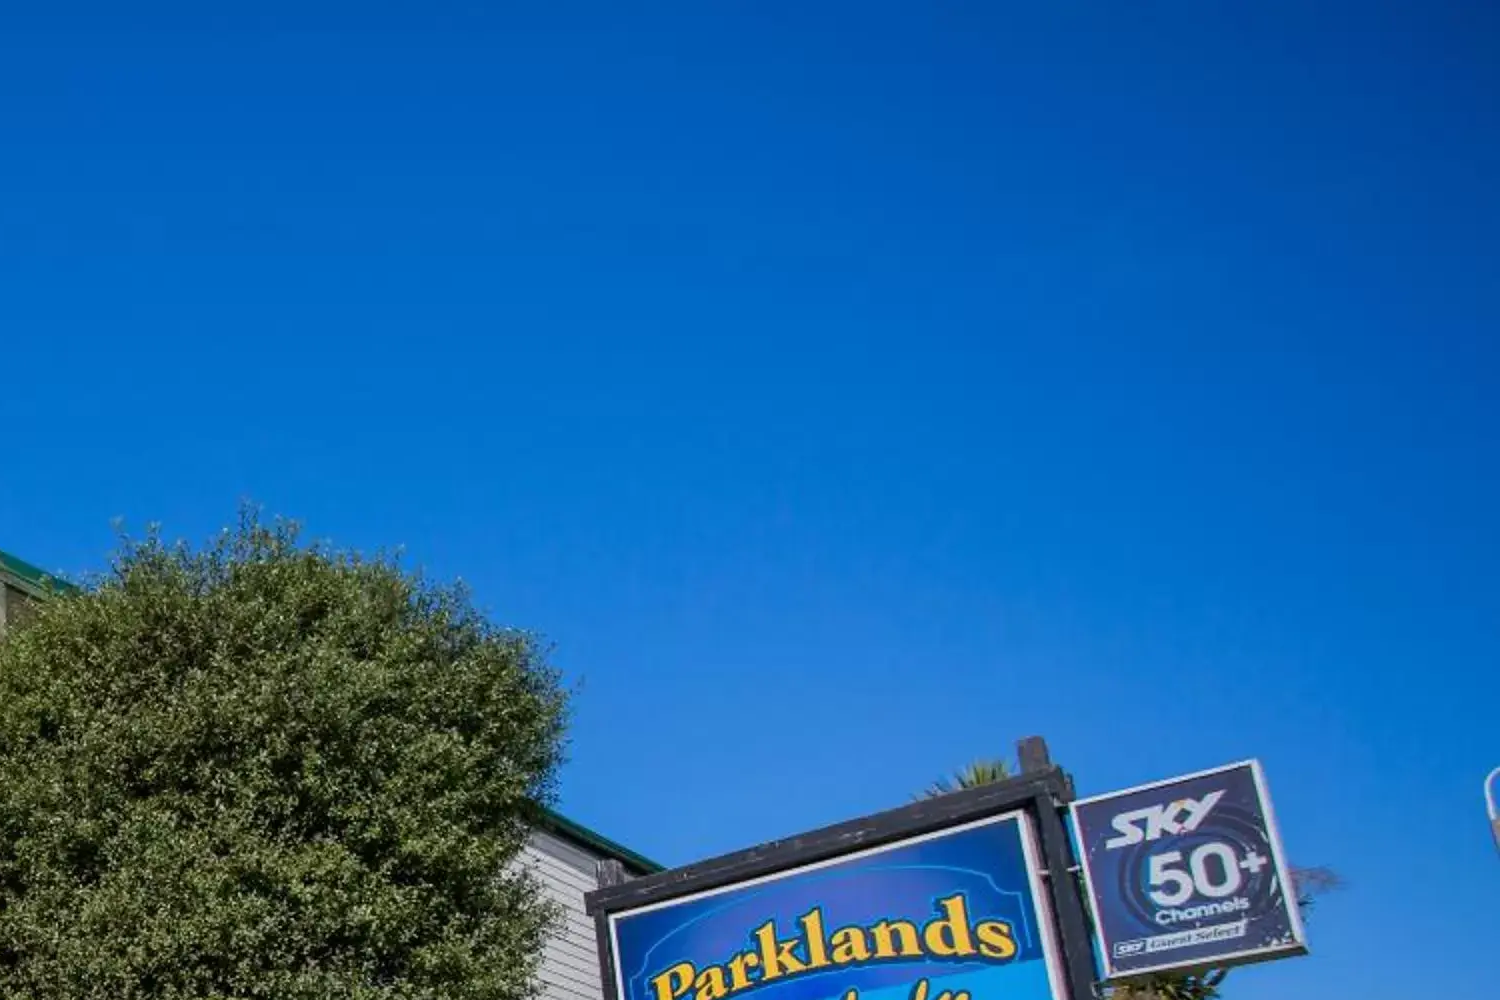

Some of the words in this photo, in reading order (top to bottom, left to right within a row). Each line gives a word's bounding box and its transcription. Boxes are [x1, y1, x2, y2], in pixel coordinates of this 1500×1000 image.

[1106, 789, 1227, 848] SKY
[1149, 842, 1267, 906] 50+
[1156, 897, 1249, 924] Channels
